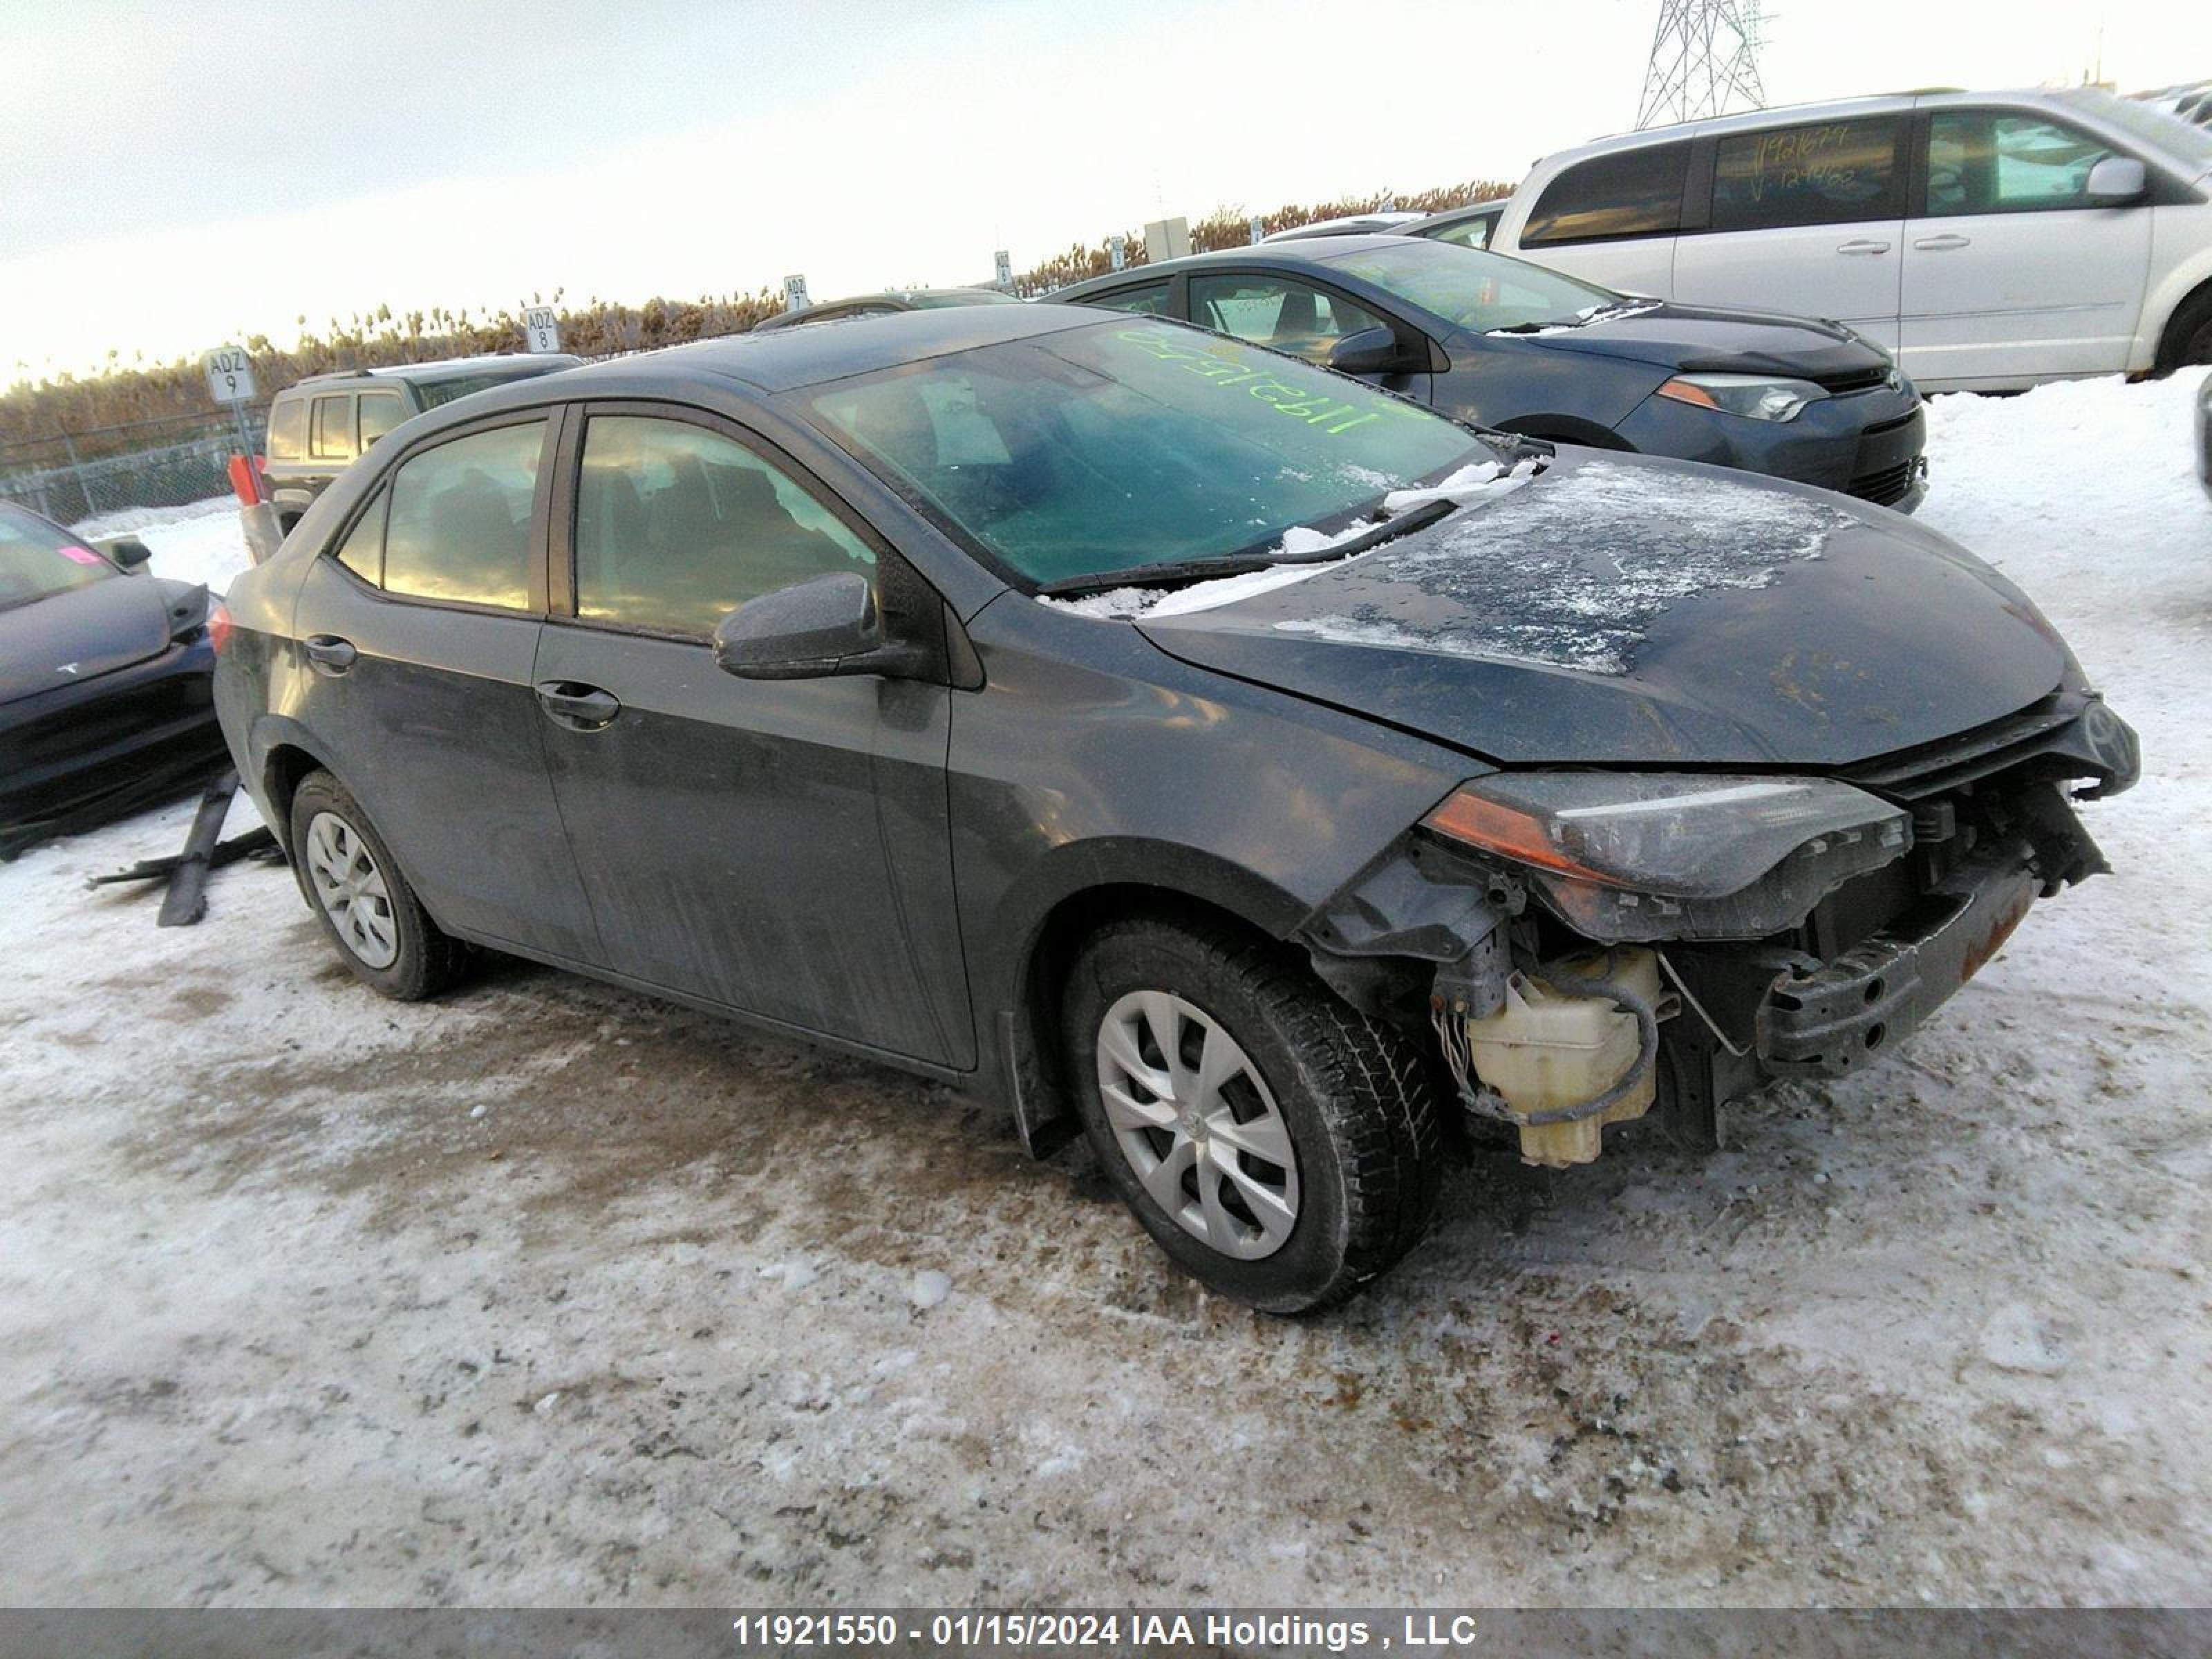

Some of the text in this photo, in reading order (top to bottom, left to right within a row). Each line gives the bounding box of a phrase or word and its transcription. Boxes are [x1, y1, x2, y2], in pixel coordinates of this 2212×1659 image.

[787, 279, 804, 295] ADZ
[529, 312, 552, 331] ADZ
[539, 331, 548, 349] 8
[210, 352, 244, 375] ADZ
[226, 374, 237, 393] 9
